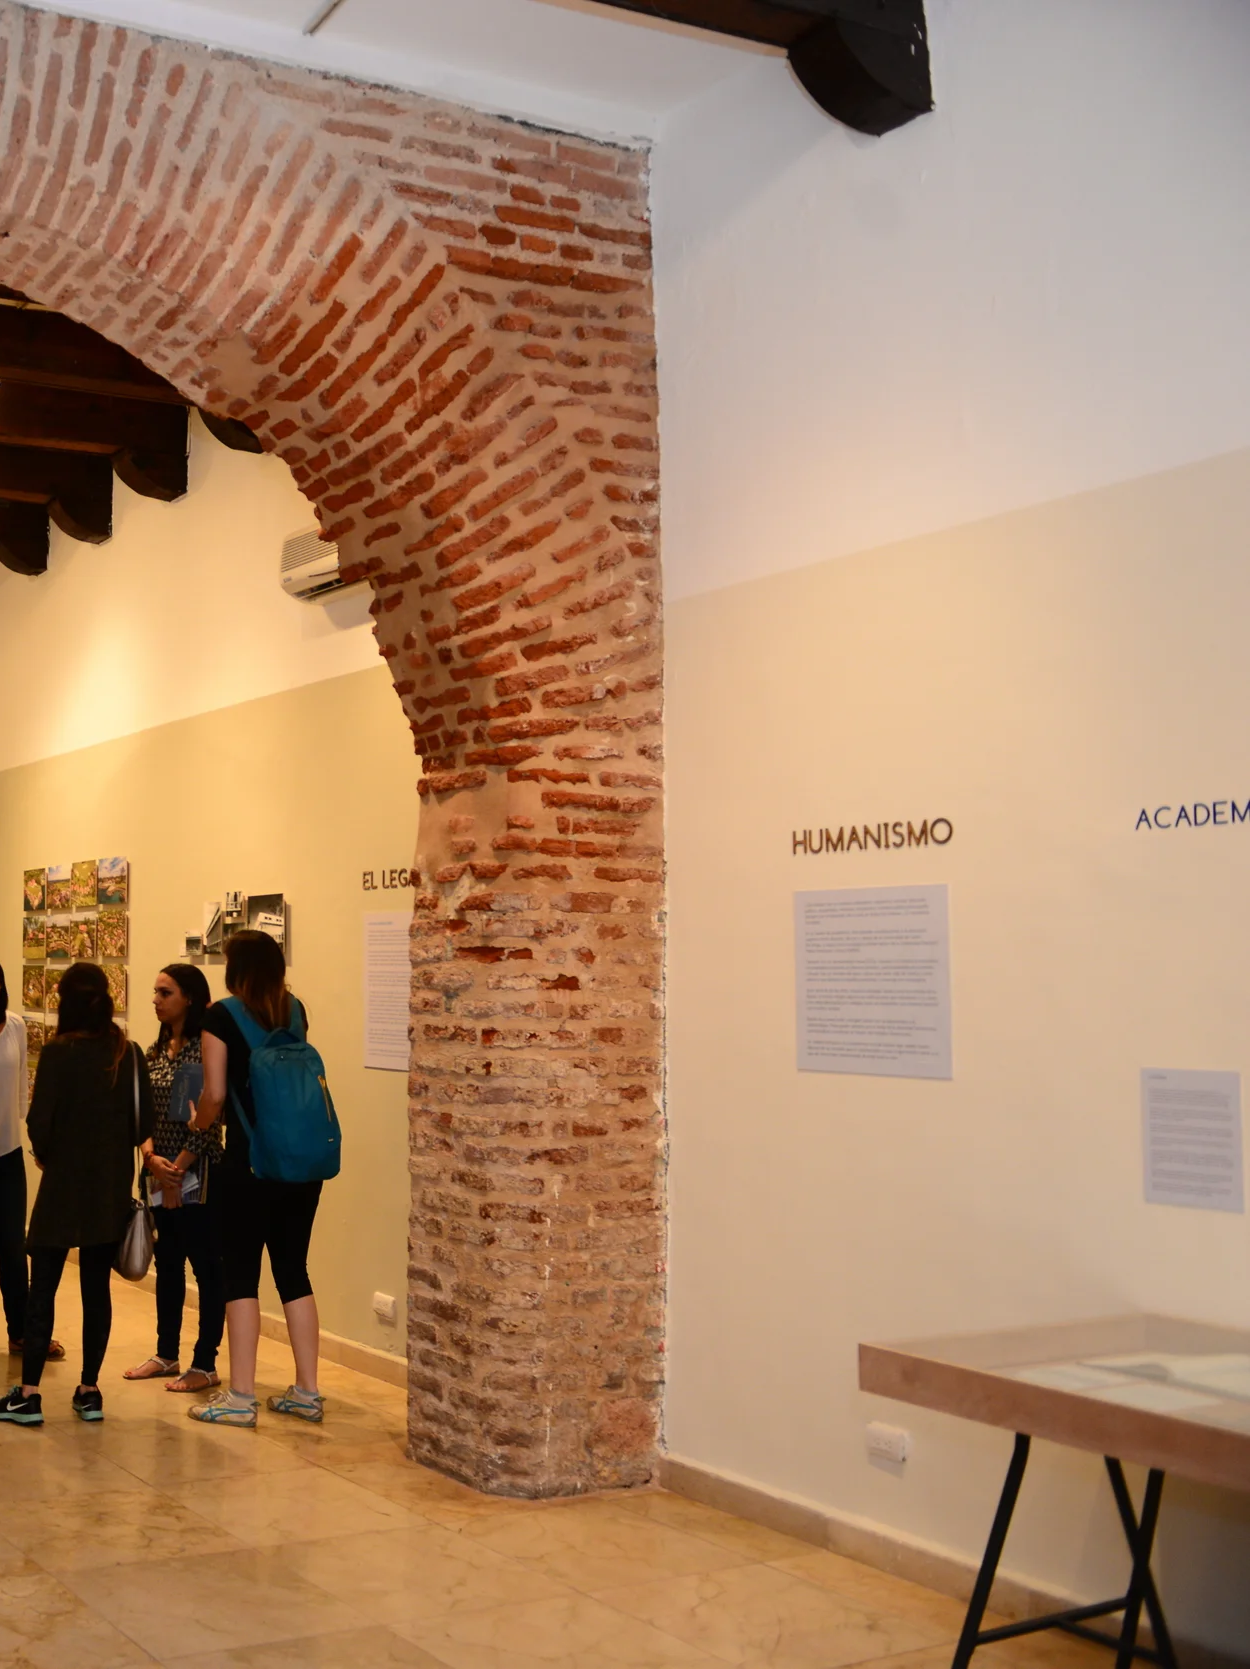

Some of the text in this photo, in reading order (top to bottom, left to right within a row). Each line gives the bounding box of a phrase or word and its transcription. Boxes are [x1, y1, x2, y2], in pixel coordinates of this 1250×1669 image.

[1135, 799, 1250, 831] ACADEM
[792, 817, 953, 855] HUMANISMO
[362, 870, 378, 890] EL
